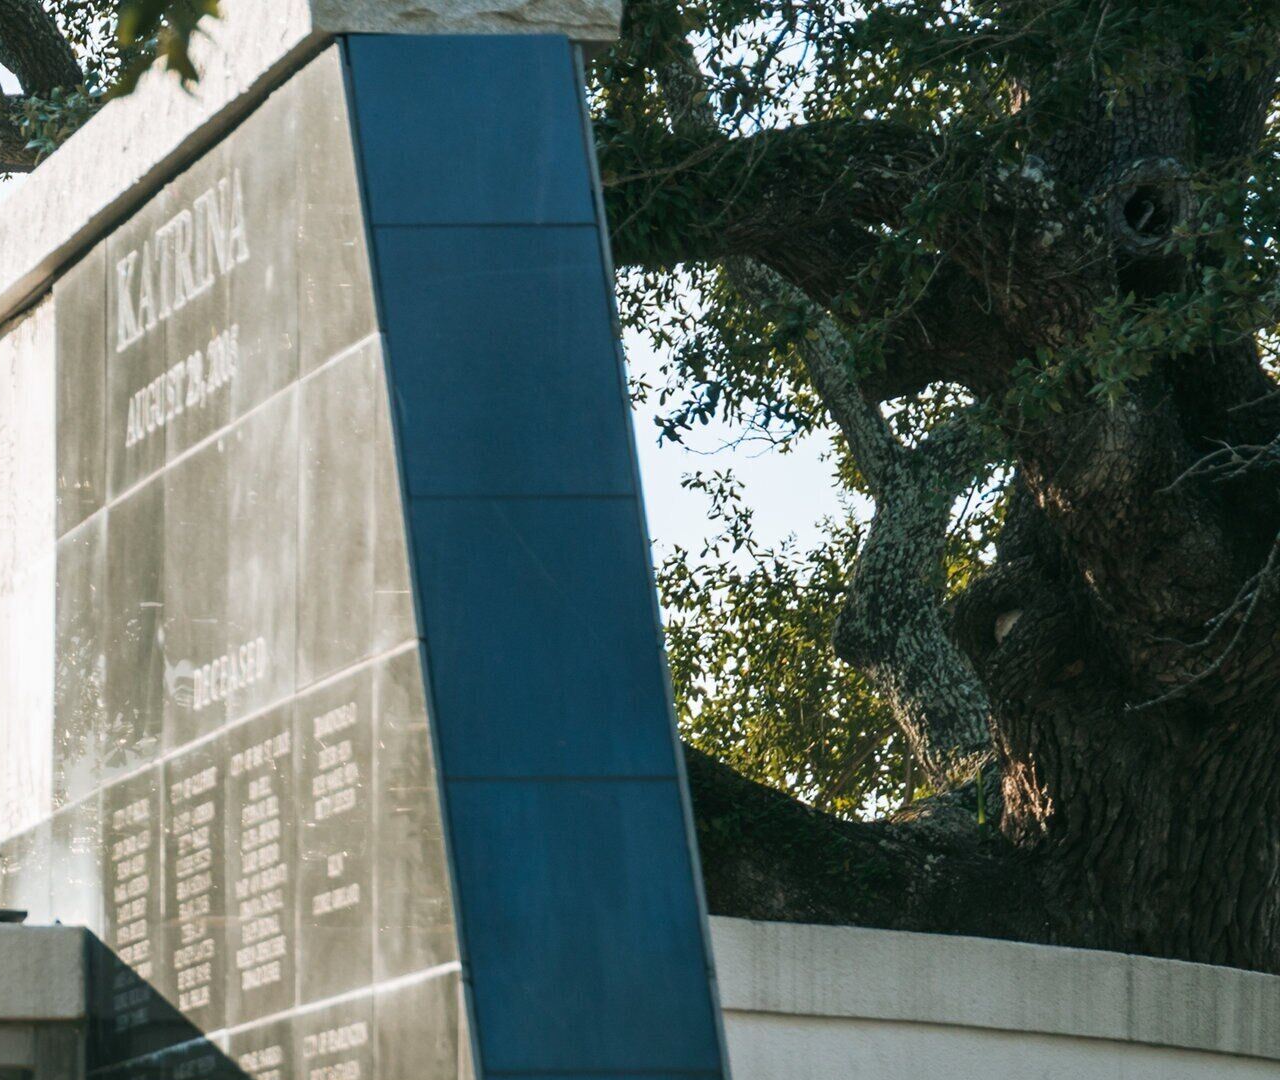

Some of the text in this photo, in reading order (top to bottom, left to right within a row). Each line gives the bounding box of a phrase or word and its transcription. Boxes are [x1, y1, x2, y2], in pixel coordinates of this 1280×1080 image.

[116, 167, 250, 353] KATRINA
[125, 359, 186, 448] AUGUST
[192, 636, 265, 711] DECEASED
